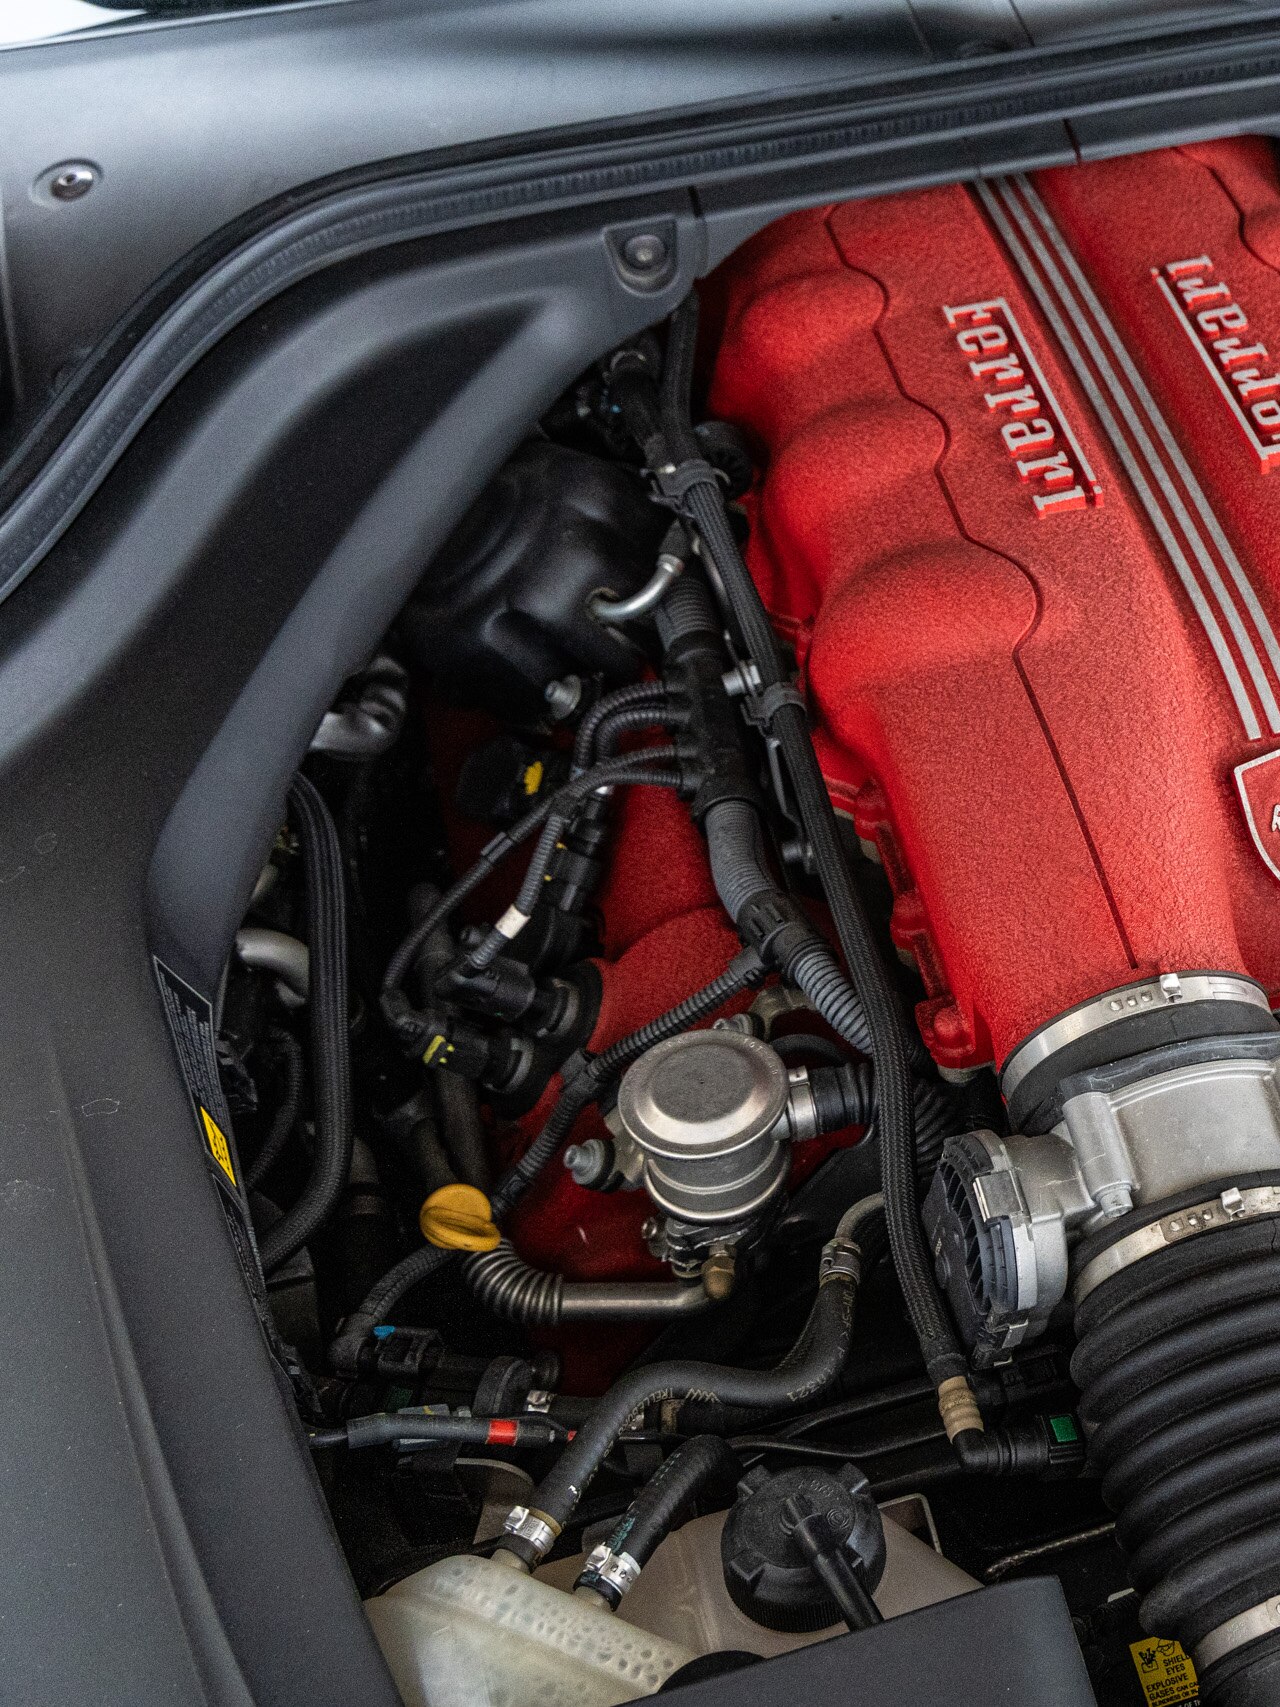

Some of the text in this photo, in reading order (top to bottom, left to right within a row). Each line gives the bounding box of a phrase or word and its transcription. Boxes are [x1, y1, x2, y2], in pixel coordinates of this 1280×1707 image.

[943, 298, 1104, 518] Ferrari
[1165, 1663, 1186, 1675] EYES
[1146, 1673, 1188, 1692] EXPLOSIVE
[1149, 1687, 1175, 1700] GASES
